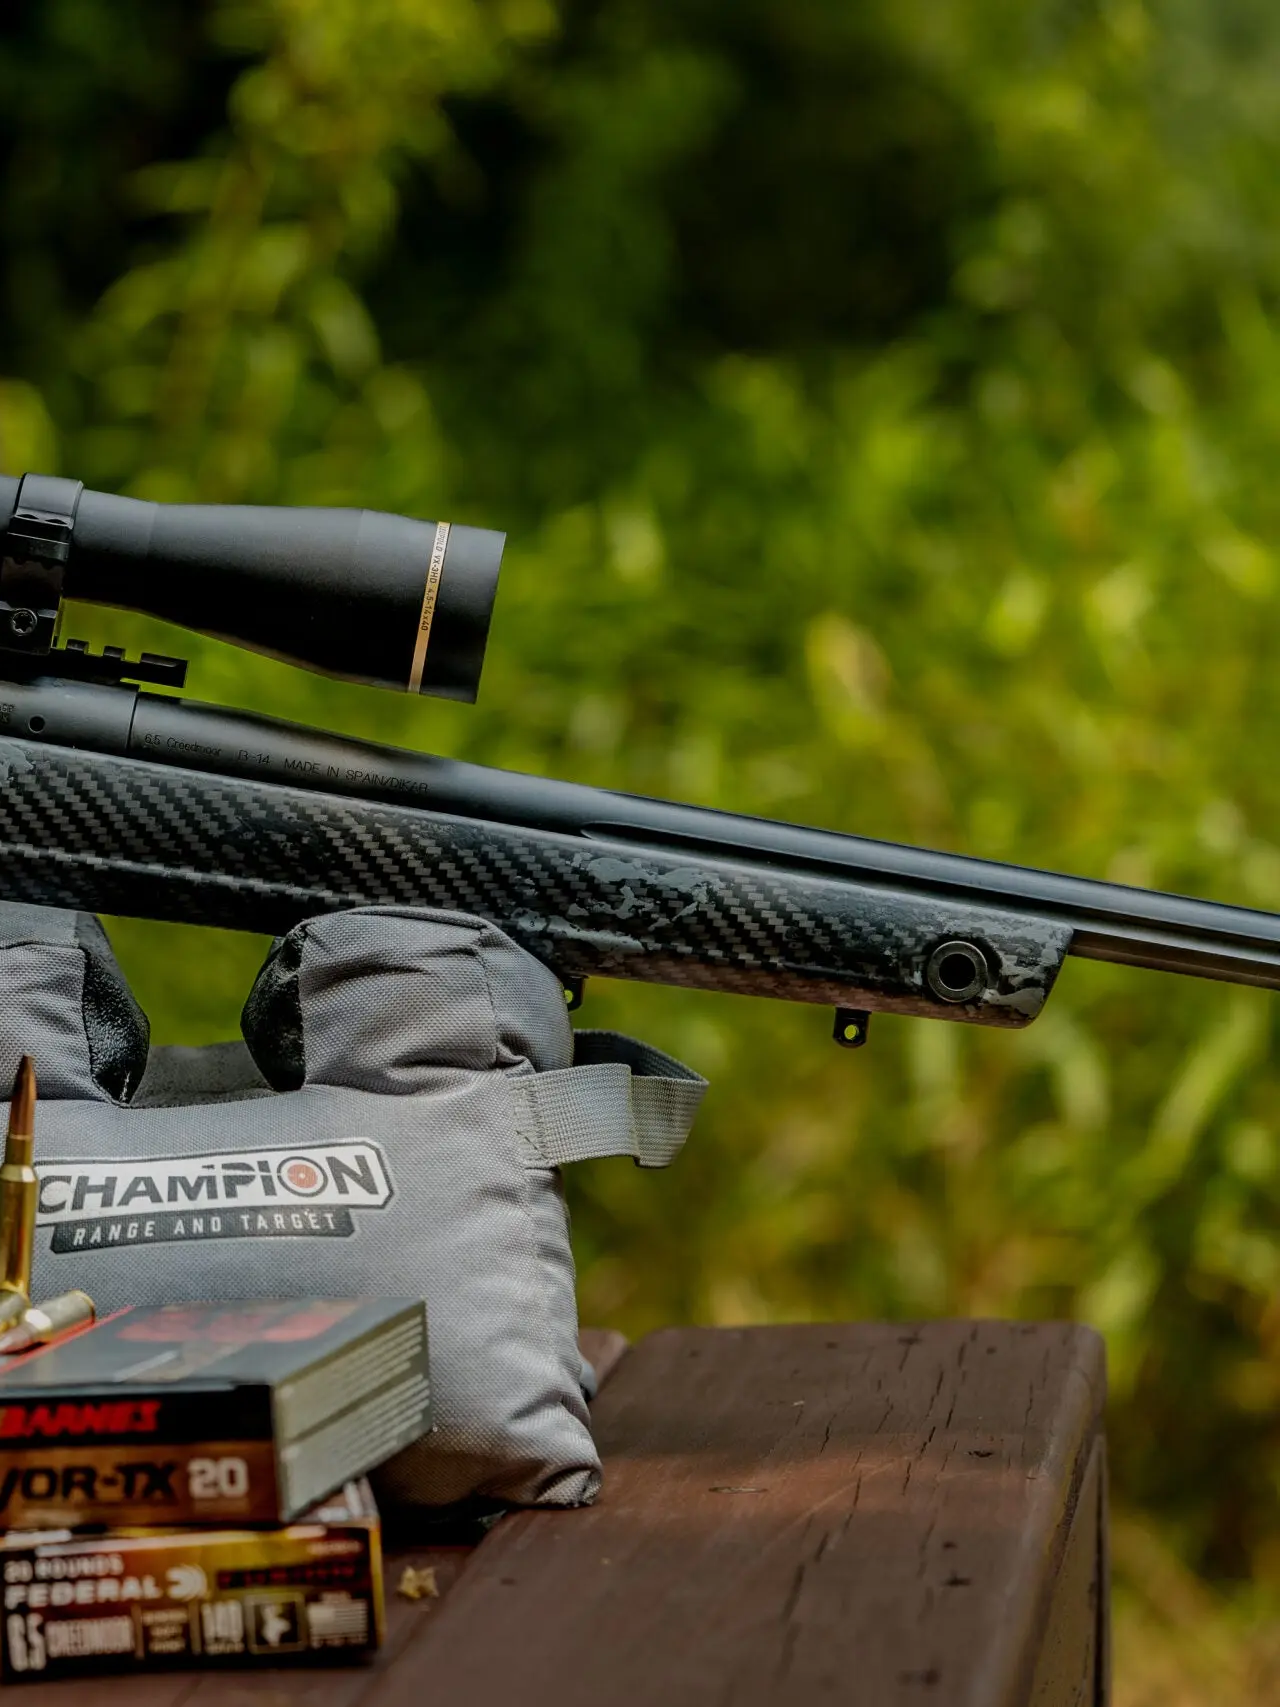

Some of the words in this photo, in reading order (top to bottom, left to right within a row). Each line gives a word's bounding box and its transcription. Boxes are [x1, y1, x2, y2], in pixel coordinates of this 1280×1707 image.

[238, 749, 271, 765] B-14
[284, 757, 321, 775] MADE
[327, 765, 340, 778] IN
[36, 1154, 380, 1214] CHAMPION
[72, 1220, 156, 1246] RANGE
[173, 1216, 223, 1236] AND
[239, 1211, 339, 1232] TARGET
[1, 1400, 162, 1437] BARNES
[188, 1457, 249, 1498] 20
[35, 1554, 124, 1578] ROUNDS
[4, 1575, 162, 1610] FEDERAL
